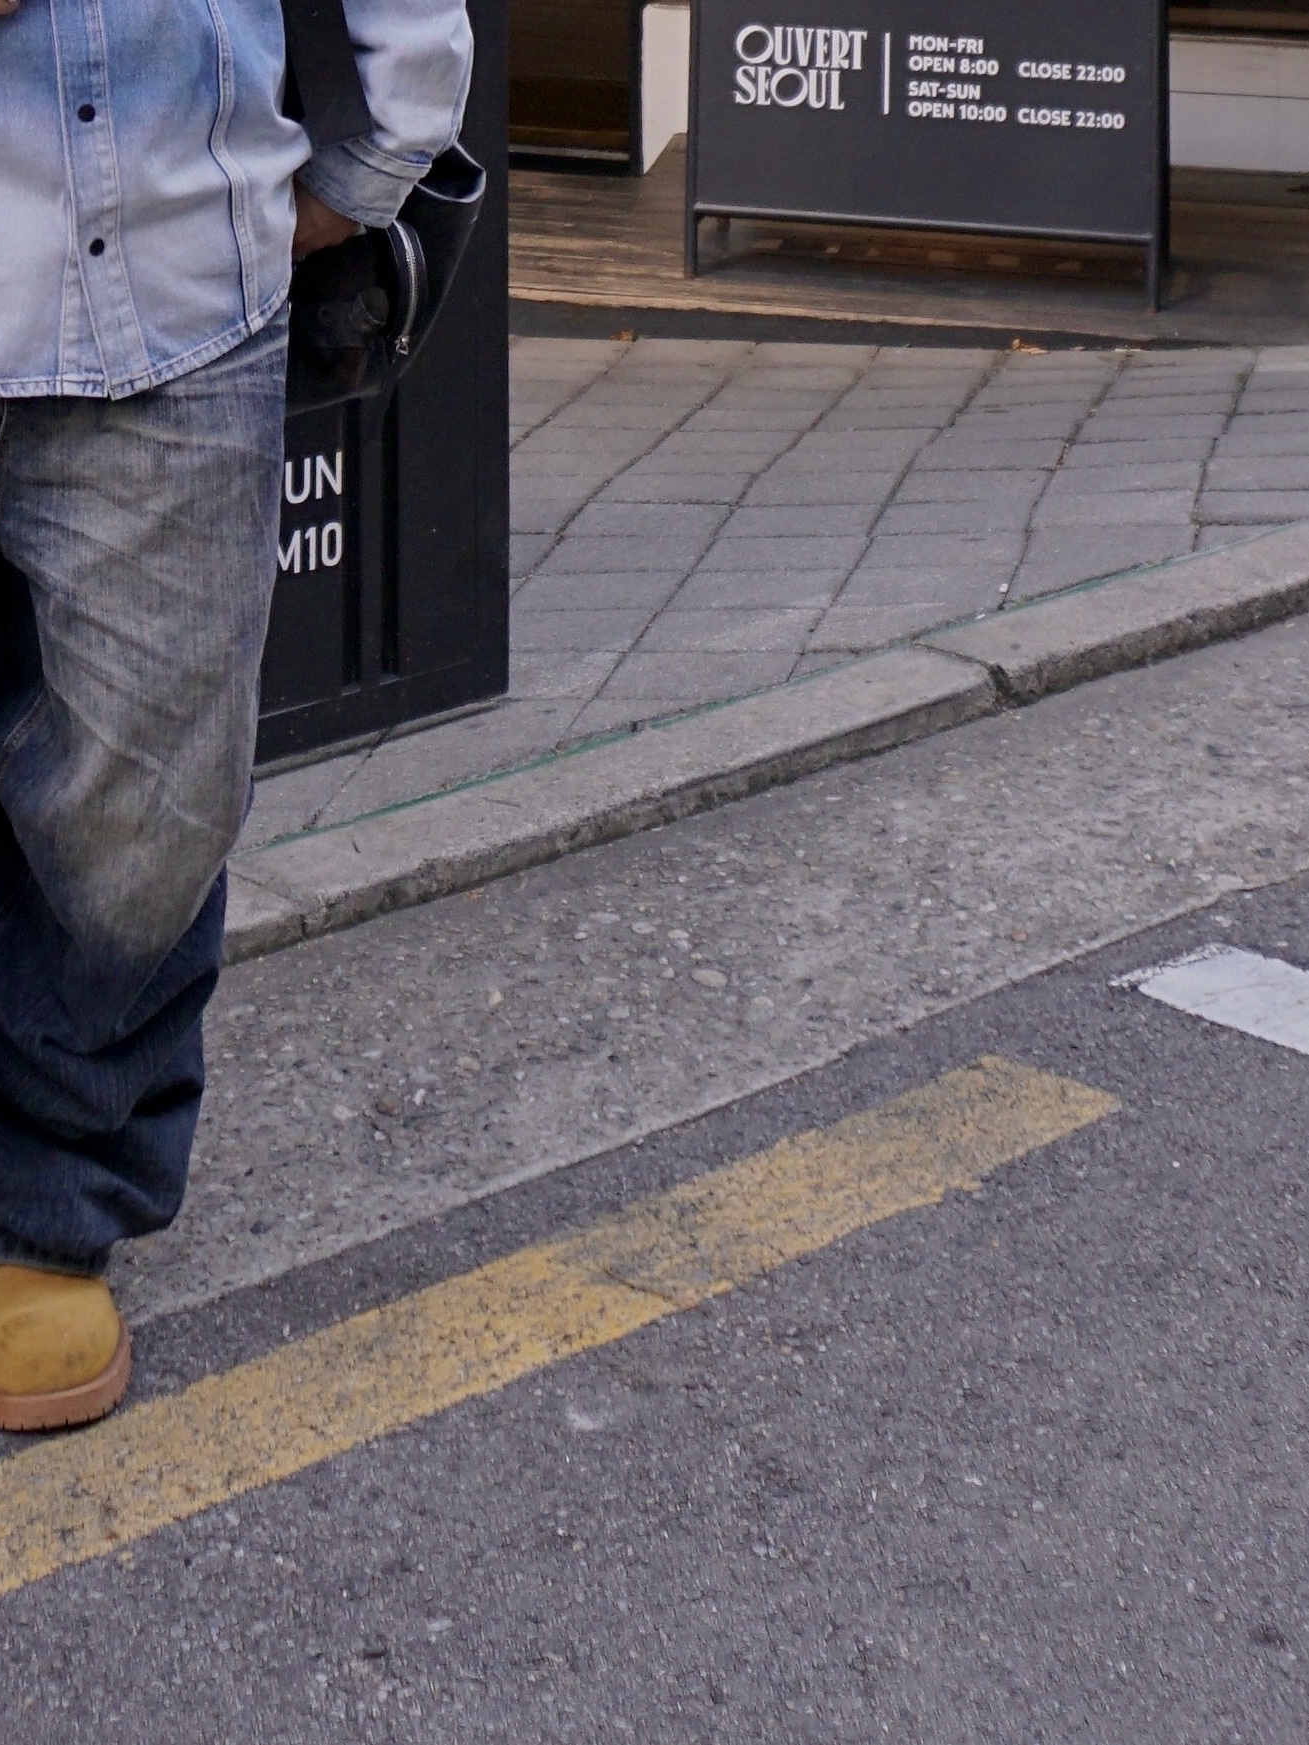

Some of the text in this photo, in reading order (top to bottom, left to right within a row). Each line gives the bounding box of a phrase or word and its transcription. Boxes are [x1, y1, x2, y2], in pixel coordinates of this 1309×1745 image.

[735, 24, 867, 71] OUVERT
[909, 34, 984, 55] MON-FRI
[908, 54, 1126, 83] OPEN 8:00 CLOSE 22:00
[733, 66, 845, 111] SEOUL
[908, 80, 981, 100] SAT-SUN
[907, 100, 1125, 130] OPEN 10:00 CLOSE 22:00
